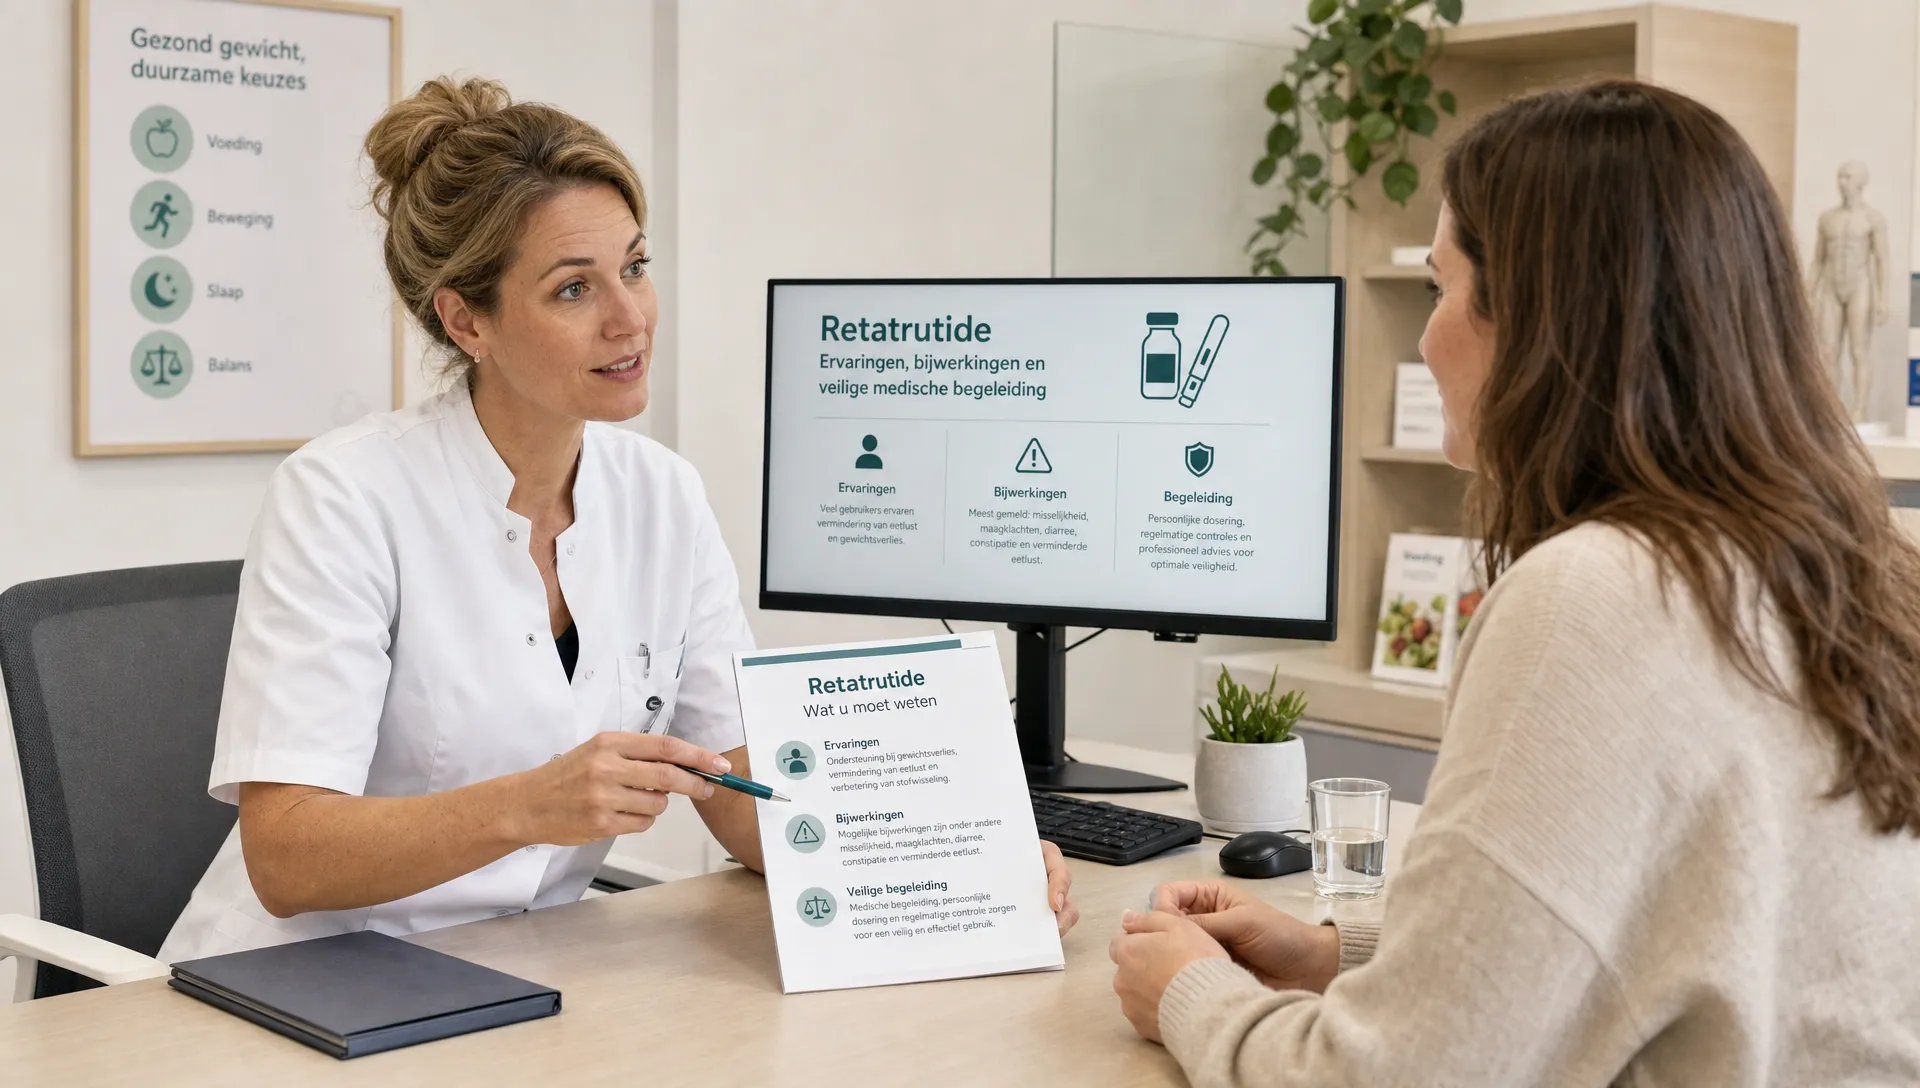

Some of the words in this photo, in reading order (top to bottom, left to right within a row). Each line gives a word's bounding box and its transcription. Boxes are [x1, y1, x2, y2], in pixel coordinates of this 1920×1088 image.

[130, 28, 212, 53] Gezond
[220, 39, 305, 62] gewicht,
[131, 58, 234, 84] duurzame
[241, 66, 306, 90] keuzes
[206, 134, 263, 155] Voeding
[208, 209, 274, 230] Beweging
[207, 284, 244, 301] Slaap
[821, 314, 991, 342] Retatrutide
[208, 358, 252, 372] Balans
[820, 353, 909, 373] Ervaringen,
[914, 354, 1020, 374] bijwerkingen
[1025, 358, 1045, 370] en
[819, 379, 868, 398] veilige
[873, 380, 948, 395] medische
[953, 380, 1047, 400] begeleiding
[838, 482, 896, 496] Ervaringen
[994, 486, 1067, 501] Bijwerkingen
[1164, 491, 1233, 507] Begeleiding
[820, 504, 837, 513] Veel
[839, 505, 882, 516] gebruikers
[968, 509, 994, 518] Meest
[996, 510, 1030, 520] gemeld:
[1033, 510, 1089, 522] misselijkheid,
[817, 519, 871, 531] vermindering
[890, 522, 918, 530] eetlust
[1148, 514, 1201, 527] Persoonlijke
[980, 524, 1042, 535] maagklachten,
[1044, 526, 1077, 536] diarree,
[1140, 530, 1194, 541] regelmatige
[1196, 532, 1238, 541] controles
[828, 535, 838, 543] en
[840, 535, 905, 545] gewichtsverlies.
[970, 539, 1017, 551] constipatie
[1020, 541, 1030, 549] en
[1033, 541, 1088, 551] verminderde
[1139, 544, 1199, 555] professioneel
[1201, 546, 1231, 557] advies
[1233, 549, 1254, 557] voor
[1011, 555, 1043, 565] eetlust.
[1151, 560, 1190, 571] optimale
[1192, 561, 1238, 573] veiligheid.
[808, 670, 925, 695] Retatrutide
[803, 704, 835, 718] Wat
[839, 705, 849, 715] u
[853, 699, 891, 714] moet
[894, 696, 938, 710] weten
[824, 738, 880, 750] Ervaringen
[826, 753, 885, 765] Ondersteuning
[886, 751, 896, 762] bij
[828, 766, 882, 779] vermindering
[883, 766, 898, 774] van
[900, 761, 927, 773] eetlust
[831, 780, 879, 792] verbetering
[880, 780, 895, 788] van
[896, 774, 951, 787] stofwisseling.
[835, 810, 904, 825] Bijwerkingen
[838, 828, 878, 840] Mogelijke
[879, 824, 932, 838] bijwerkingen
[933, 823, 947, 832] zijn
[949, 821, 973, 830] onder
[974, 818, 1002, 828] andere
[842, 854, 887, 866] constipatie
[888, 855, 899, 863] en
[901, 848, 951, 862] verminderde
[846, 885, 884, 897] Veilige
[886, 880, 948, 895] begeleiding
[850, 900, 889, 912] Medische
[942, 892, 991, 905] persoonlijke
[852, 914, 888, 926] dosering
[890, 915, 900, 923] en
[902, 908, 950, 922] regelmatige
[952, 905, 987, 918] controle
[988, 904, 1017, 914] zorgen
[853, 932, 873, 940] voor
[875, 929, 890, 938] een
[915, 926, 926, 934] en
[962, 920, 996, 932] gebruik.
